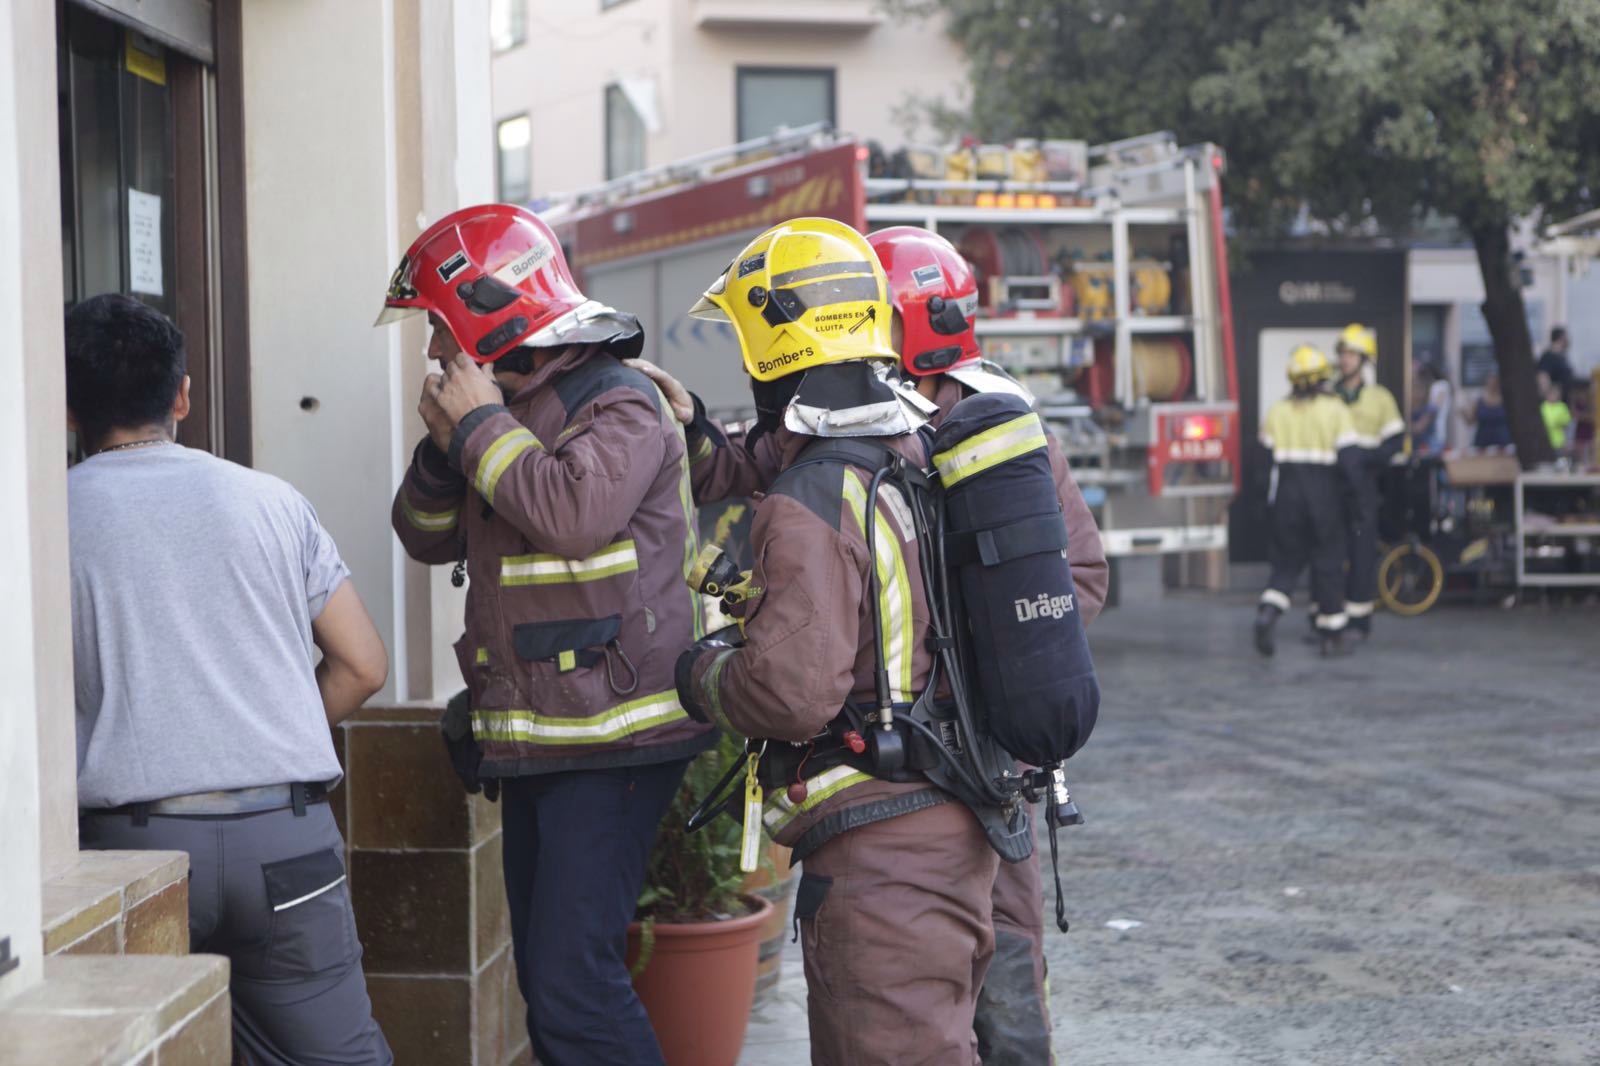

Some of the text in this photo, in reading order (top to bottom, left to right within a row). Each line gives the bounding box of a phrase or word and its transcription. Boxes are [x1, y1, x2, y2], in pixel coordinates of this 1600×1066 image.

[815, 312, 853, 323] BOMBERS
[816, 324, 844, 333] LLUITA
[757, 346, 814, 374] Bombers
[1014, 593, 1074, 623] Dräger
